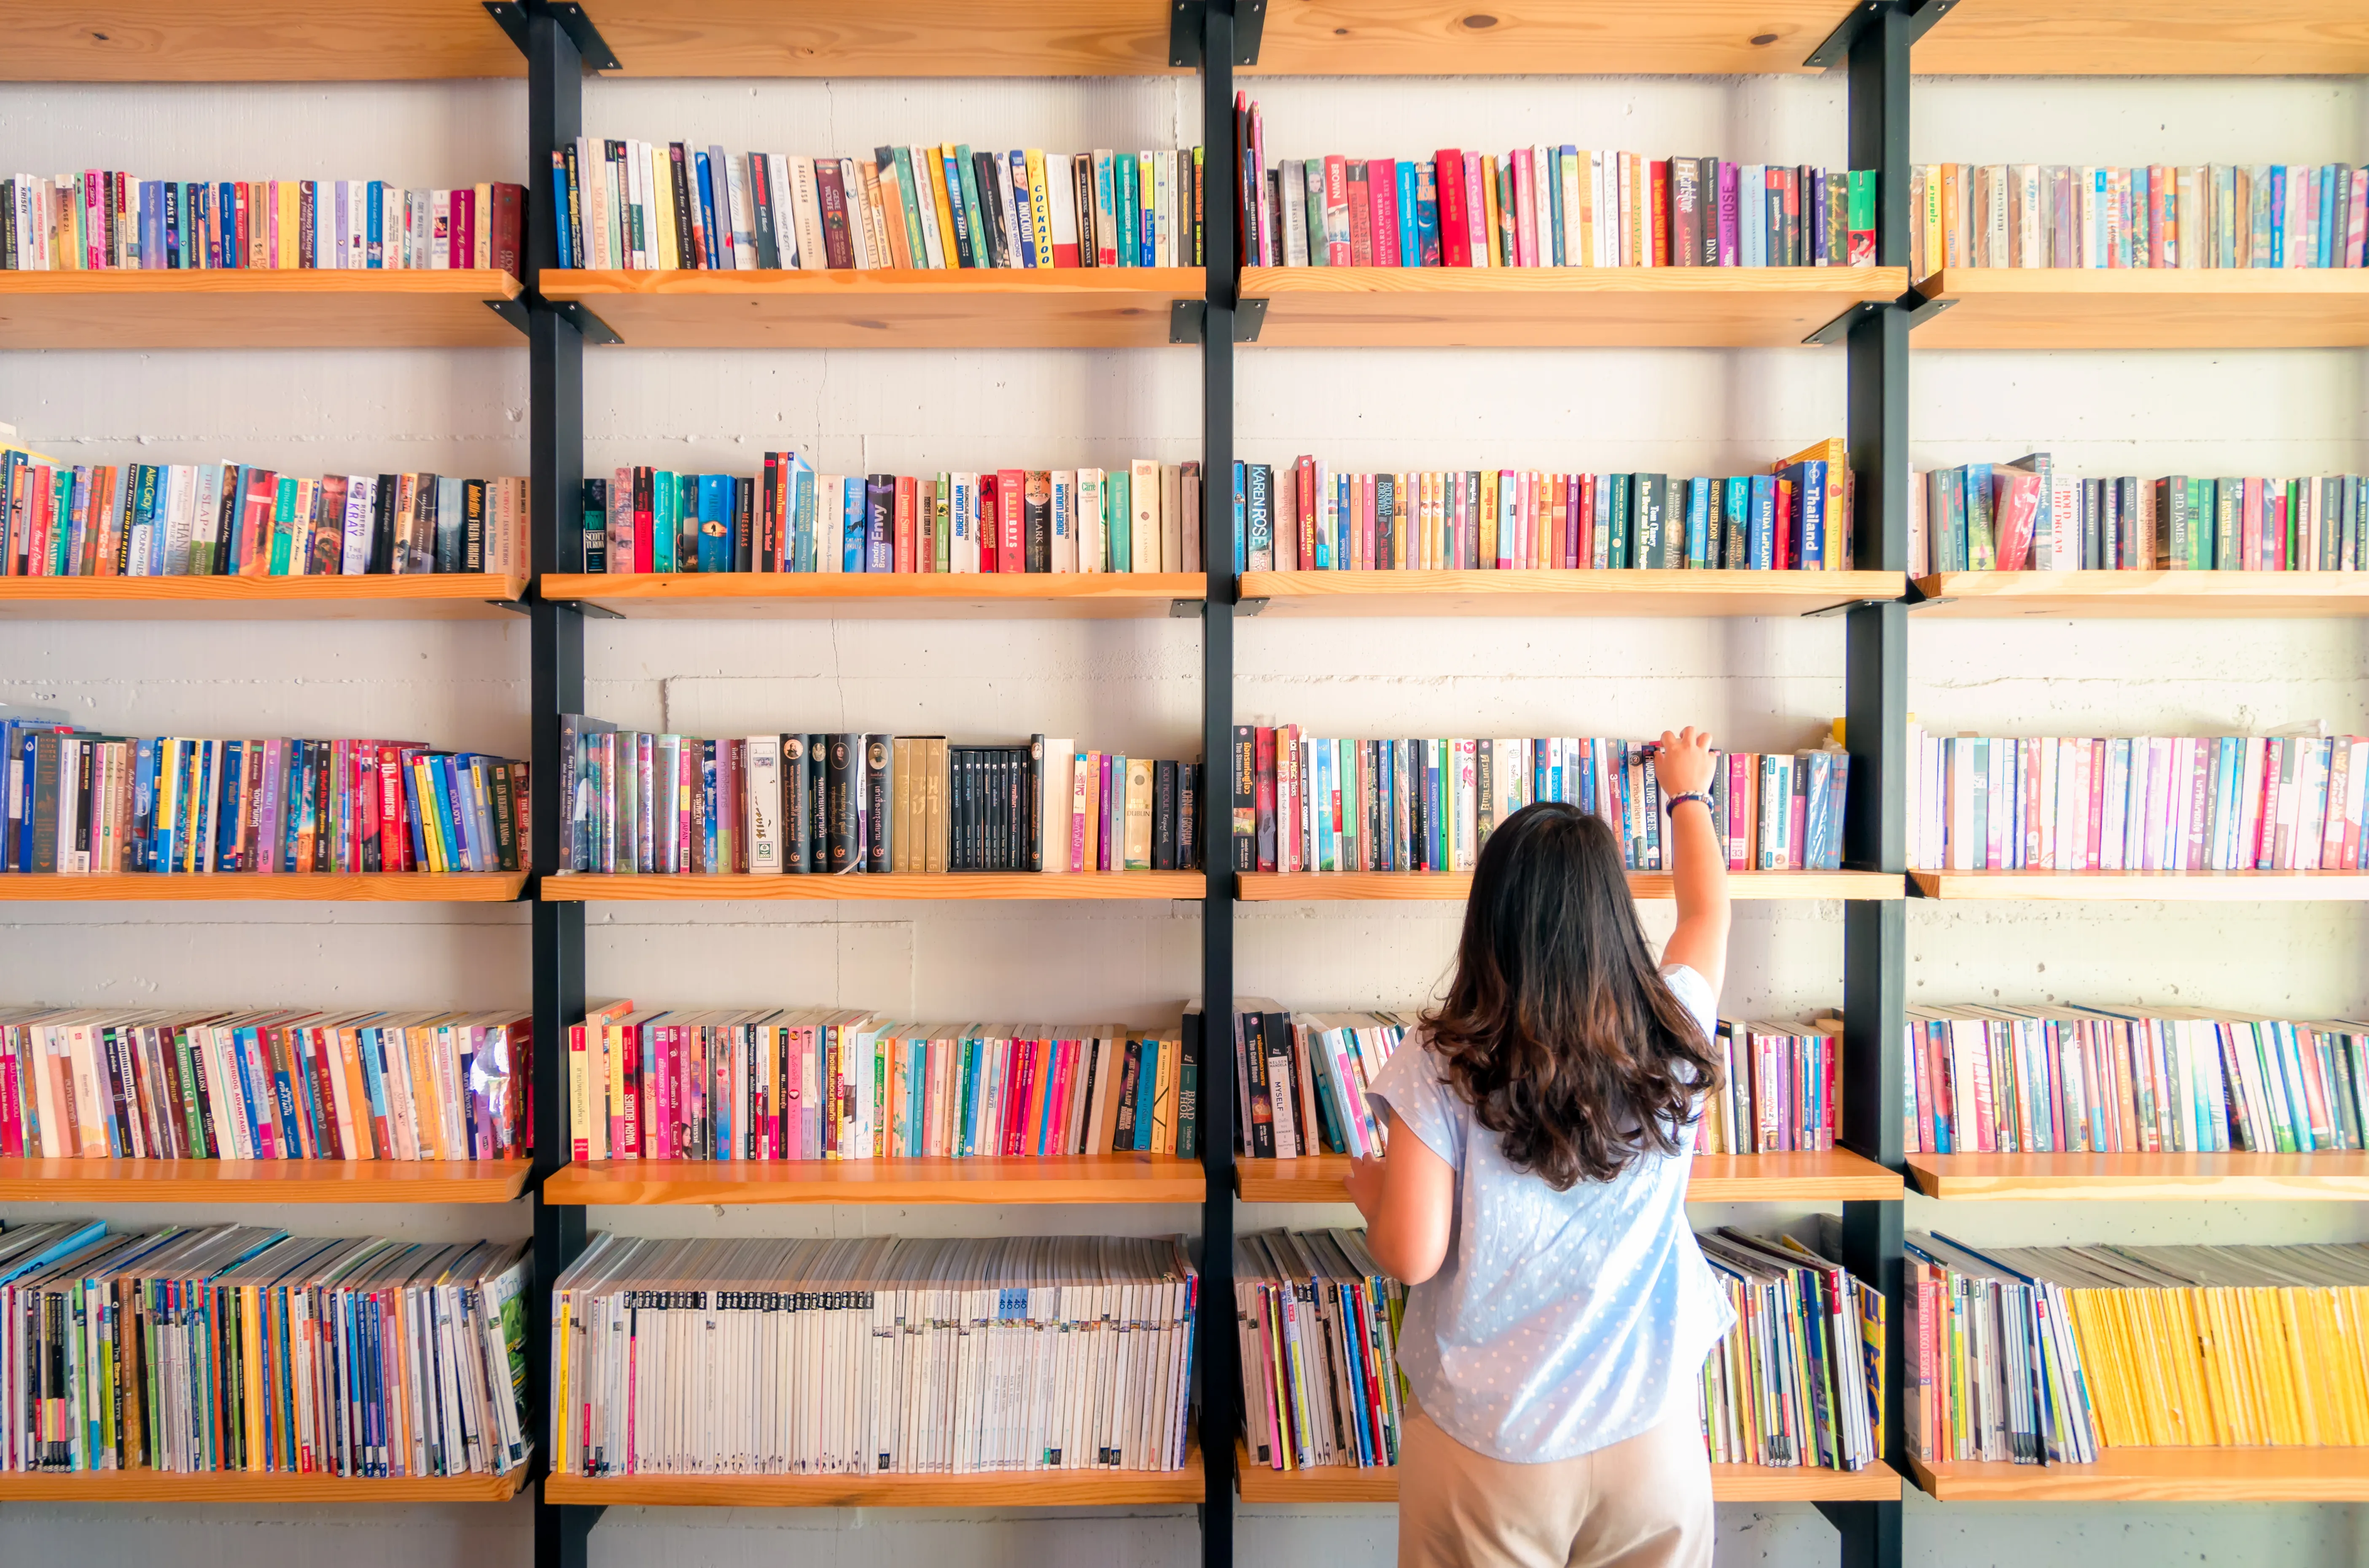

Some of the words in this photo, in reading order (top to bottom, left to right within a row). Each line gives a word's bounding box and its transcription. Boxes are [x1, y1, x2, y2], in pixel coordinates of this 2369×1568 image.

[798, 165, 808, 204] BACKLASH
[1331, 163, 1341, 199] BROWN
[36, 192, 44, 212] CHRONIC
[595, 187, 603, 218] MORAL
[825, 186, 833, 210] WOLFE
[1018, 201, 1033, 242] KNOCKOUT
[1034, 185, 1051, 264] COCKATOO
[1082, 217, 1090, 238] GRAND
[597, 220, 607, 265] FICTION
[1012, 234, 1021, 257] WRONG
[145, 467, 156, 486] Alex
[1253, 467, 1266, 506] KAREN
[140, 487, 153, 508] Gray
[777, 483, 785, 514] นิทานไทย
[901, 495, 910, 517] DANIELLE
[956, 486, 964, 511] LUDLUM
[1378, 482, 1386, 515] CORNWELL
[1711, 481, 1720, 505] SIDNEY
[2063, 490, 2071, 518] HOLD
[2175, 494, 2184, 509] P.D.
[200, 494, 211, 526] SLAP
[347, 503, 357, 536] KRAY
[871, 505, 887, 540] Envy
[1649, 506, 1659, 520] Tom
[1710, 507, 1718, 539] SHELDON
[1806, 487, 1820, 550] Thailand
[469, 519, 480, 541] FREDA
[585, 532, 605, 540] SCOTT
[901, 518, 910, 535] STEEL
[956, 513, 964, 536] ROBERT
[1035, 518, 1043, 543] LARK
[1252, 508, 1267, 545] ROSE
[1648, 522, 1659, 546] Clancy
[2175, 512, 2185, 543] JAMES
[468, 543, 479, 568] BRIGHT
[1242, 743, 1253, 794] มังกรแห่งฟูโจว
[1646, 756, 1655, 785] FINANCIAL
[248, 788, 261, 827] จดหมายเหตุ
[382, 779, 396, 820] Anniversary
[449, 789, 462, 824] แต่งกับงาน
[817, 777, 826, 838] จดหมายเหตุรายวัน
[1182, 789, 1193, 806] JOHN
[1647, 787, 1656, 803] LIVES
[873, 786, 883, 840] เล่าเรื่องกรุงสยาม
[1647, 812, 1656, 830] POETS
[1181, 818, 1192, 845] GRISHAM
[178, 1043, 191, 1089] STARBUCKED
[194, 1049, 207, 1091] MISTERIOSO
[1127, 1070, 1135, 1090] LONELY
[227, 1050, 239, 1090] UNDERDOG
[234, 1093, 246, 1134] ADVANTAGE
[828, 1052, 836, 1121] โรงเรียนสอนทำธุรกิจ
[1275, 1082, 1283, 1111] MYSELF
[624, 1094, 634, 1120] BODIES
[1119, 1106, 1127, 1130] ROBBINS
[626, 1123, 635, 1145] WARM
[1919, 1284, 1930, 1322] LETTERHEAD
[1919, 1331, 1930, 1347] LOGO
[1919, 1350, 1931, 1377] DESIGNS
